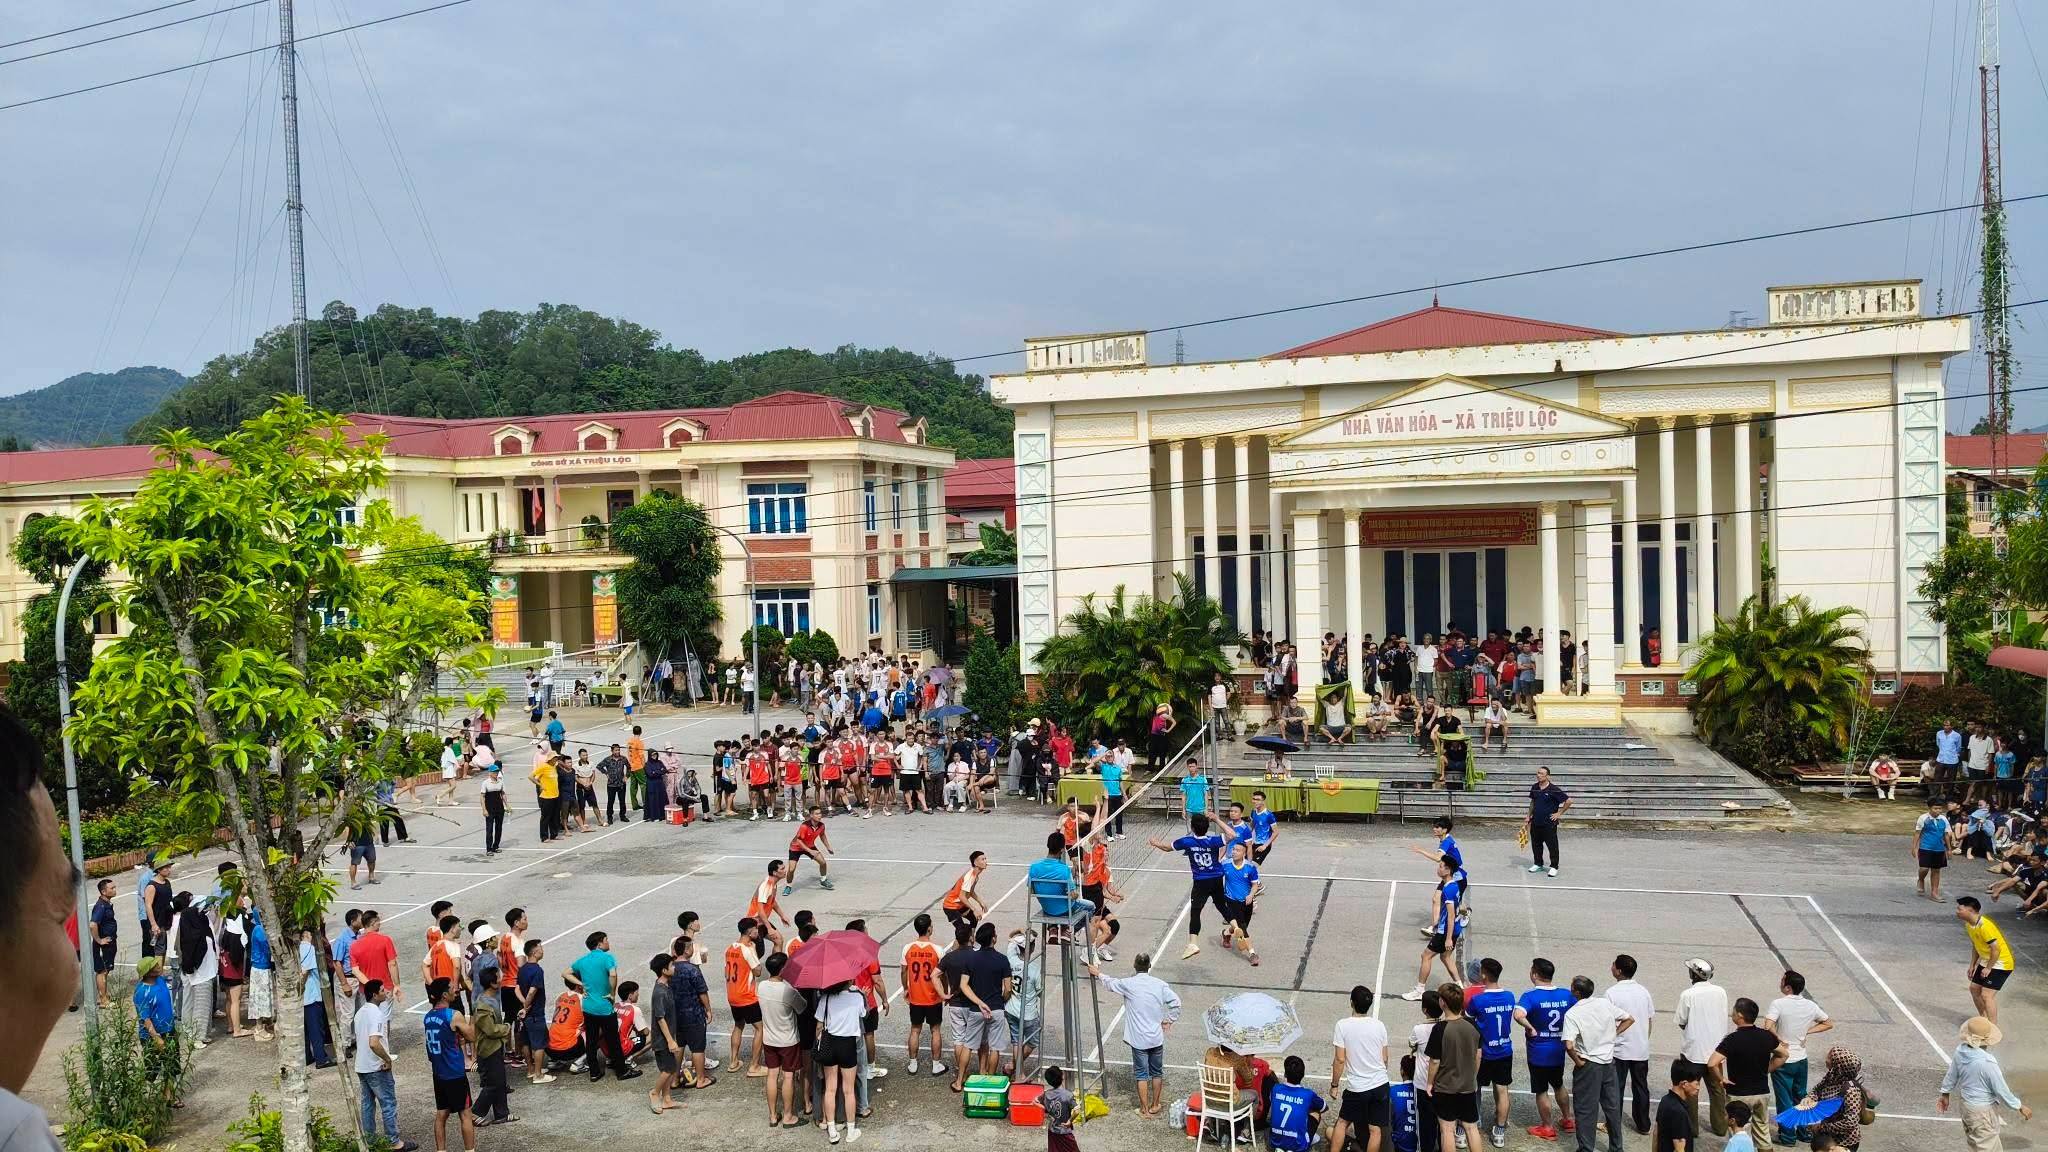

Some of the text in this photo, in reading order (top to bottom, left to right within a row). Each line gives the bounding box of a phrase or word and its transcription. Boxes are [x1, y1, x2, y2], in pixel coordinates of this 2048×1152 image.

[1342, 414, 1372, 436] NHÀ
[1376, 412, 1404, 434] VĂN
[1408, 410, 1438, 432] HÓA
[1455, 408, 1476, 430] XÃ
[1481, 407, 1525, 431] TRIỆU
[1529, 405, 1558, 431] LỘC
[583, 456, 611, 465] TRIỆU
[612, 456, 632, 464] LỘC
[911, 961, 932, 982] 93
[1496, 1014, 1502, 1036] 1
[1548, 1009, 1560, 1032] 2
[1280, 1102, 1293, 1128] 7
[1406, 1100, 1416, 1124] 5
